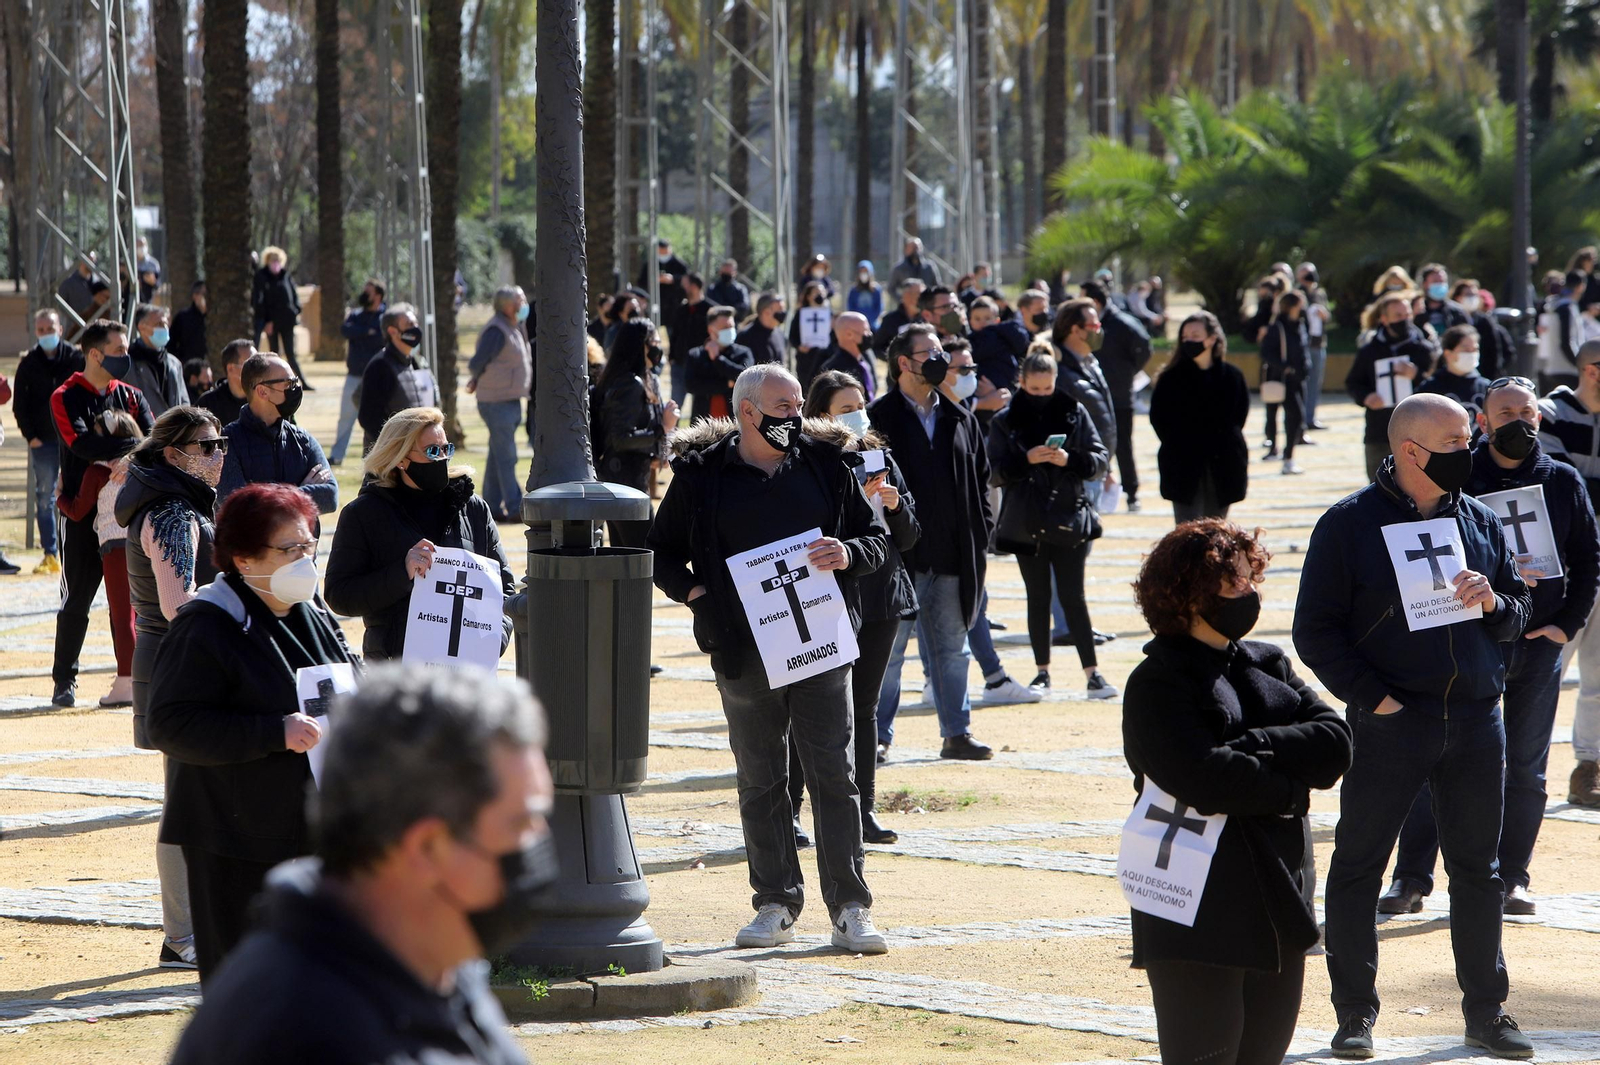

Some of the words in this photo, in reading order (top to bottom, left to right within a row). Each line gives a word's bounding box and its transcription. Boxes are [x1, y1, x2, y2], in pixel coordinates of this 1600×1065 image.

[434, 557, 461, 567] TABANCO
[467, 561, 475, 569] LA
[746, 553, 775, 568] TABANCO
[781, 548, 789, 556] LA
[771, 570, 800, 589] DEP
[445, 583, 474, 596] DEP
[801, 593, 832, 610] Camareros
[1410, 601, 1430, 610] AQUI
[1430, 593, 1466, 607] DESCAN
[417, 611, 448, 624] Artistas
[759, 609, 790, 627] Artistas
[1414, 611, 1427, 619] UN
[1427, 603, 1466, 618] AUTONOM
[462, 617, 492, 631] Camareros
[786, 641, 838, 671] ARRUINADOS
[1122, 869, 1144, 882] AQUI
[1145, 876, 1193, 898] DESCANSA
[1123, 882, 1135, 893] UN
[1136, 887, 1186, 908] AUTONOMO
